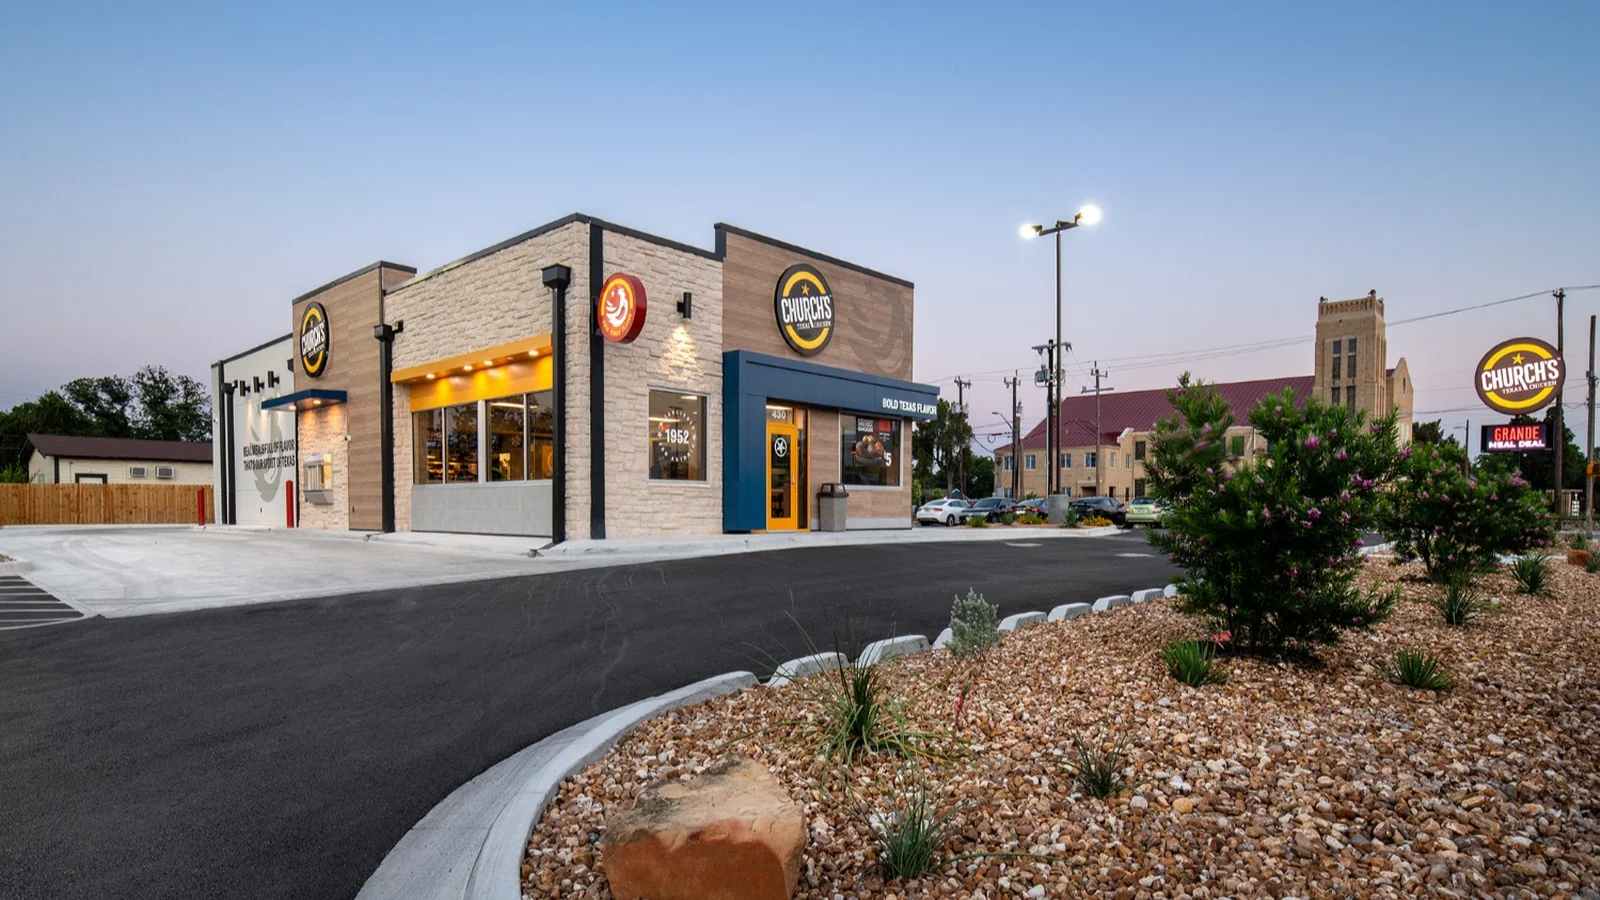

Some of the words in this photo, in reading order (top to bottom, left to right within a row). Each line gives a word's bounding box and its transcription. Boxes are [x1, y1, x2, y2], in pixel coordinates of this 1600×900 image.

[781, 295, 832, 328] CHURCH'S
[1481, 359, 1559, 391] CHURCH'S
[1502, 386, 1522, 395] TEXAS
[1529, 380, 1557, 390] CHICKEN
[882, 397, 899, 410] BOLD
[899, 400, 916, 412] TEXAS
[917, 402, 937, 415] FLAVOR
[771, 410, 787, 420] 430
[665, 428, 689, 445] 1952
[1494, 426, 1540, 442] GRANDE
[1488, 441, 1517, 449] MEAL
[1518, 439, 1546, 448] DEAL
